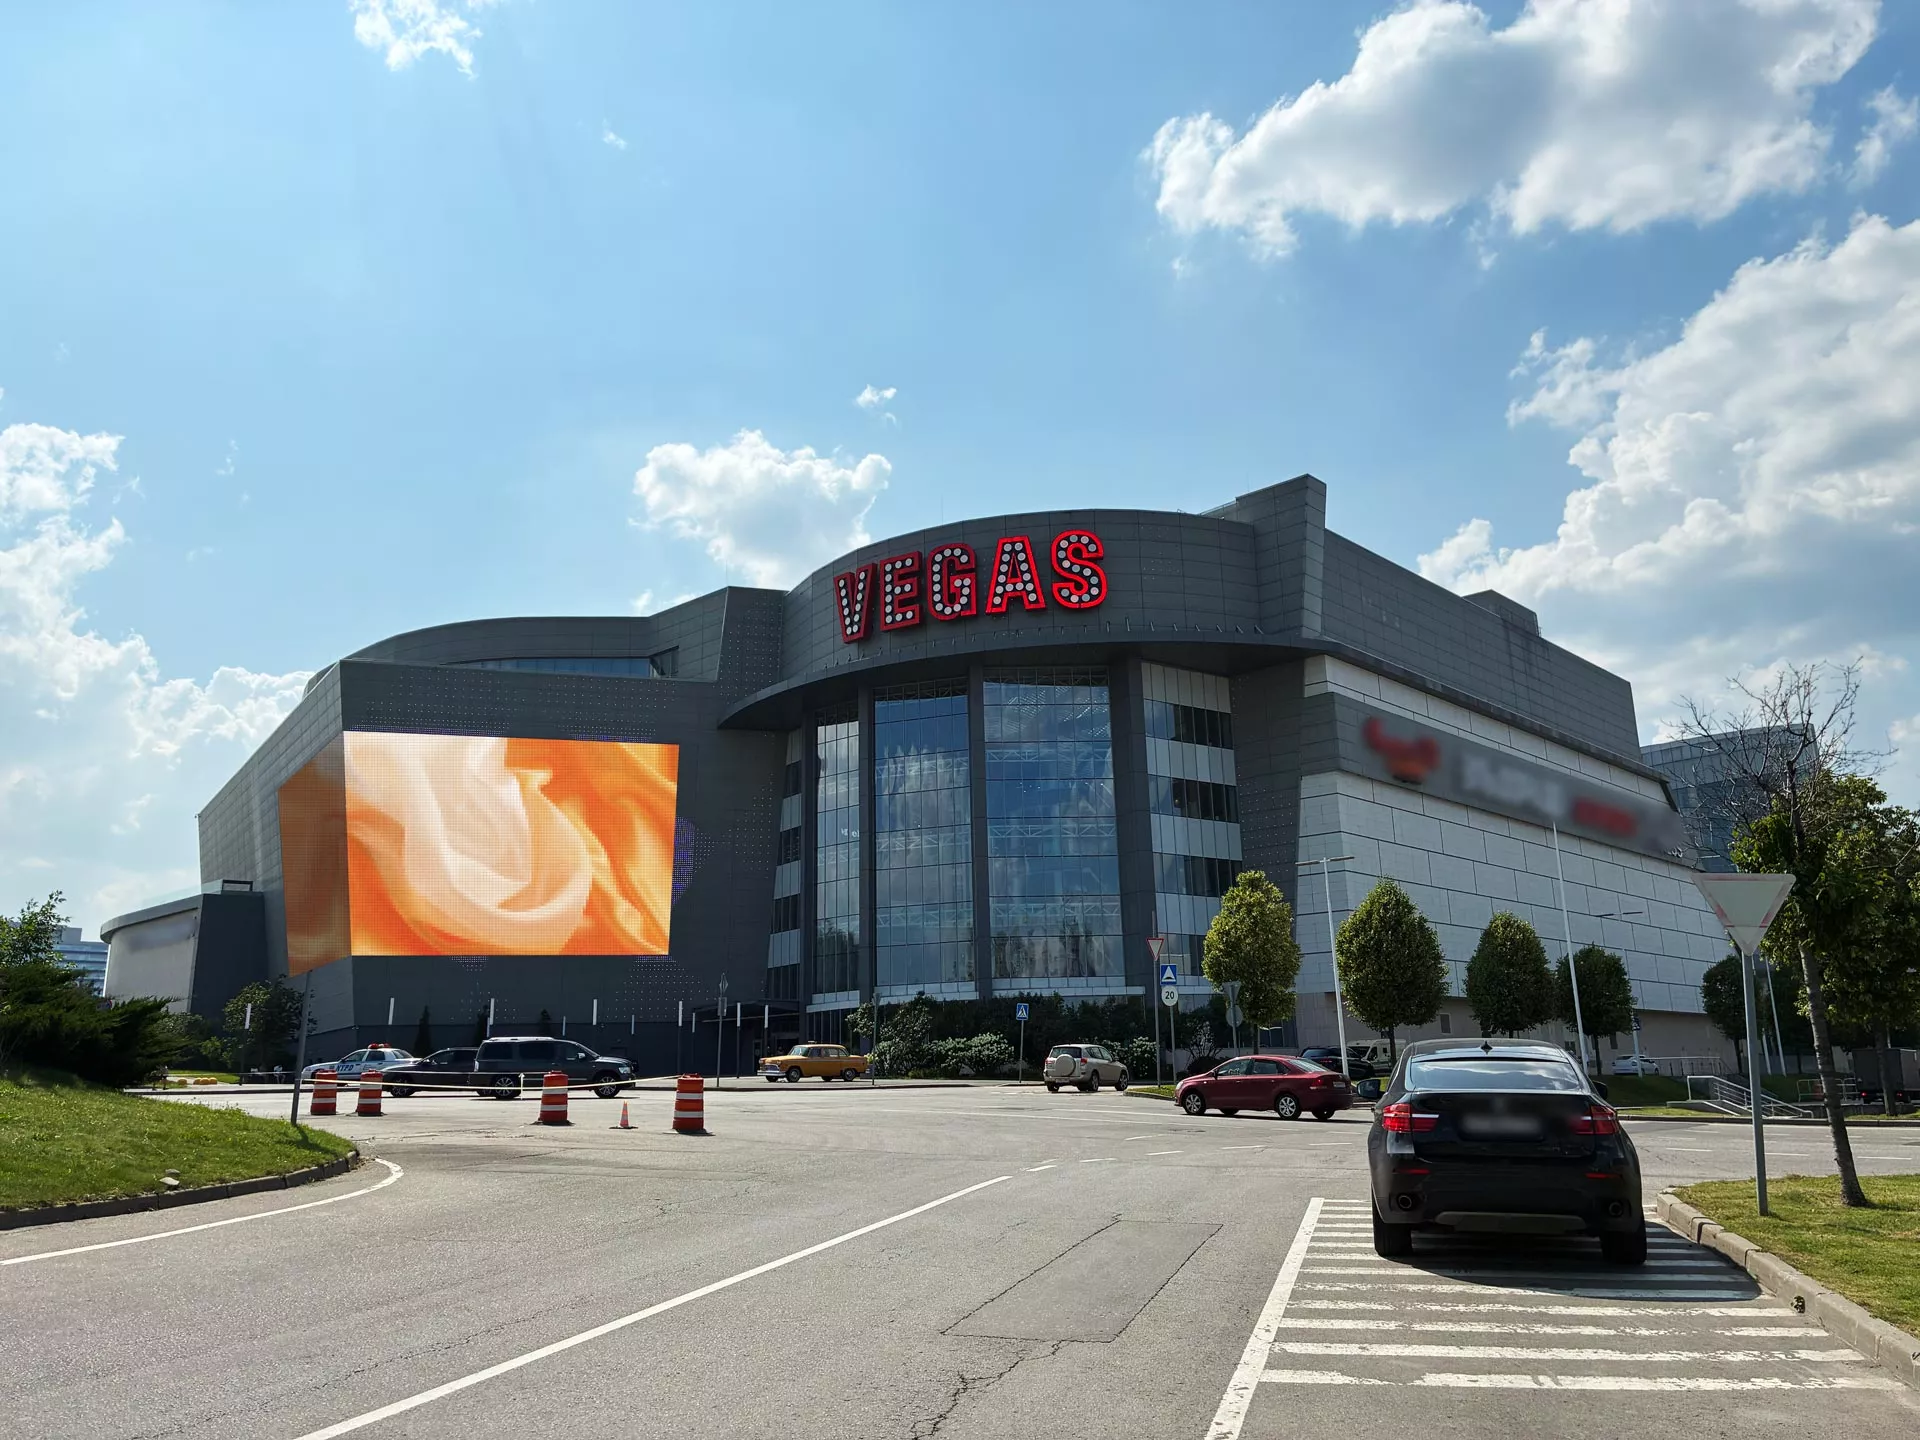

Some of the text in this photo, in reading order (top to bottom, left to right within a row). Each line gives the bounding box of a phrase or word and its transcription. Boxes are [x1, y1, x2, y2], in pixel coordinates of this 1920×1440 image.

[834, 529, 1108, 643] VEGAS
[1165, 991, 1175, 1000] 20
[336, 1064, 354, 1072] NYPD
